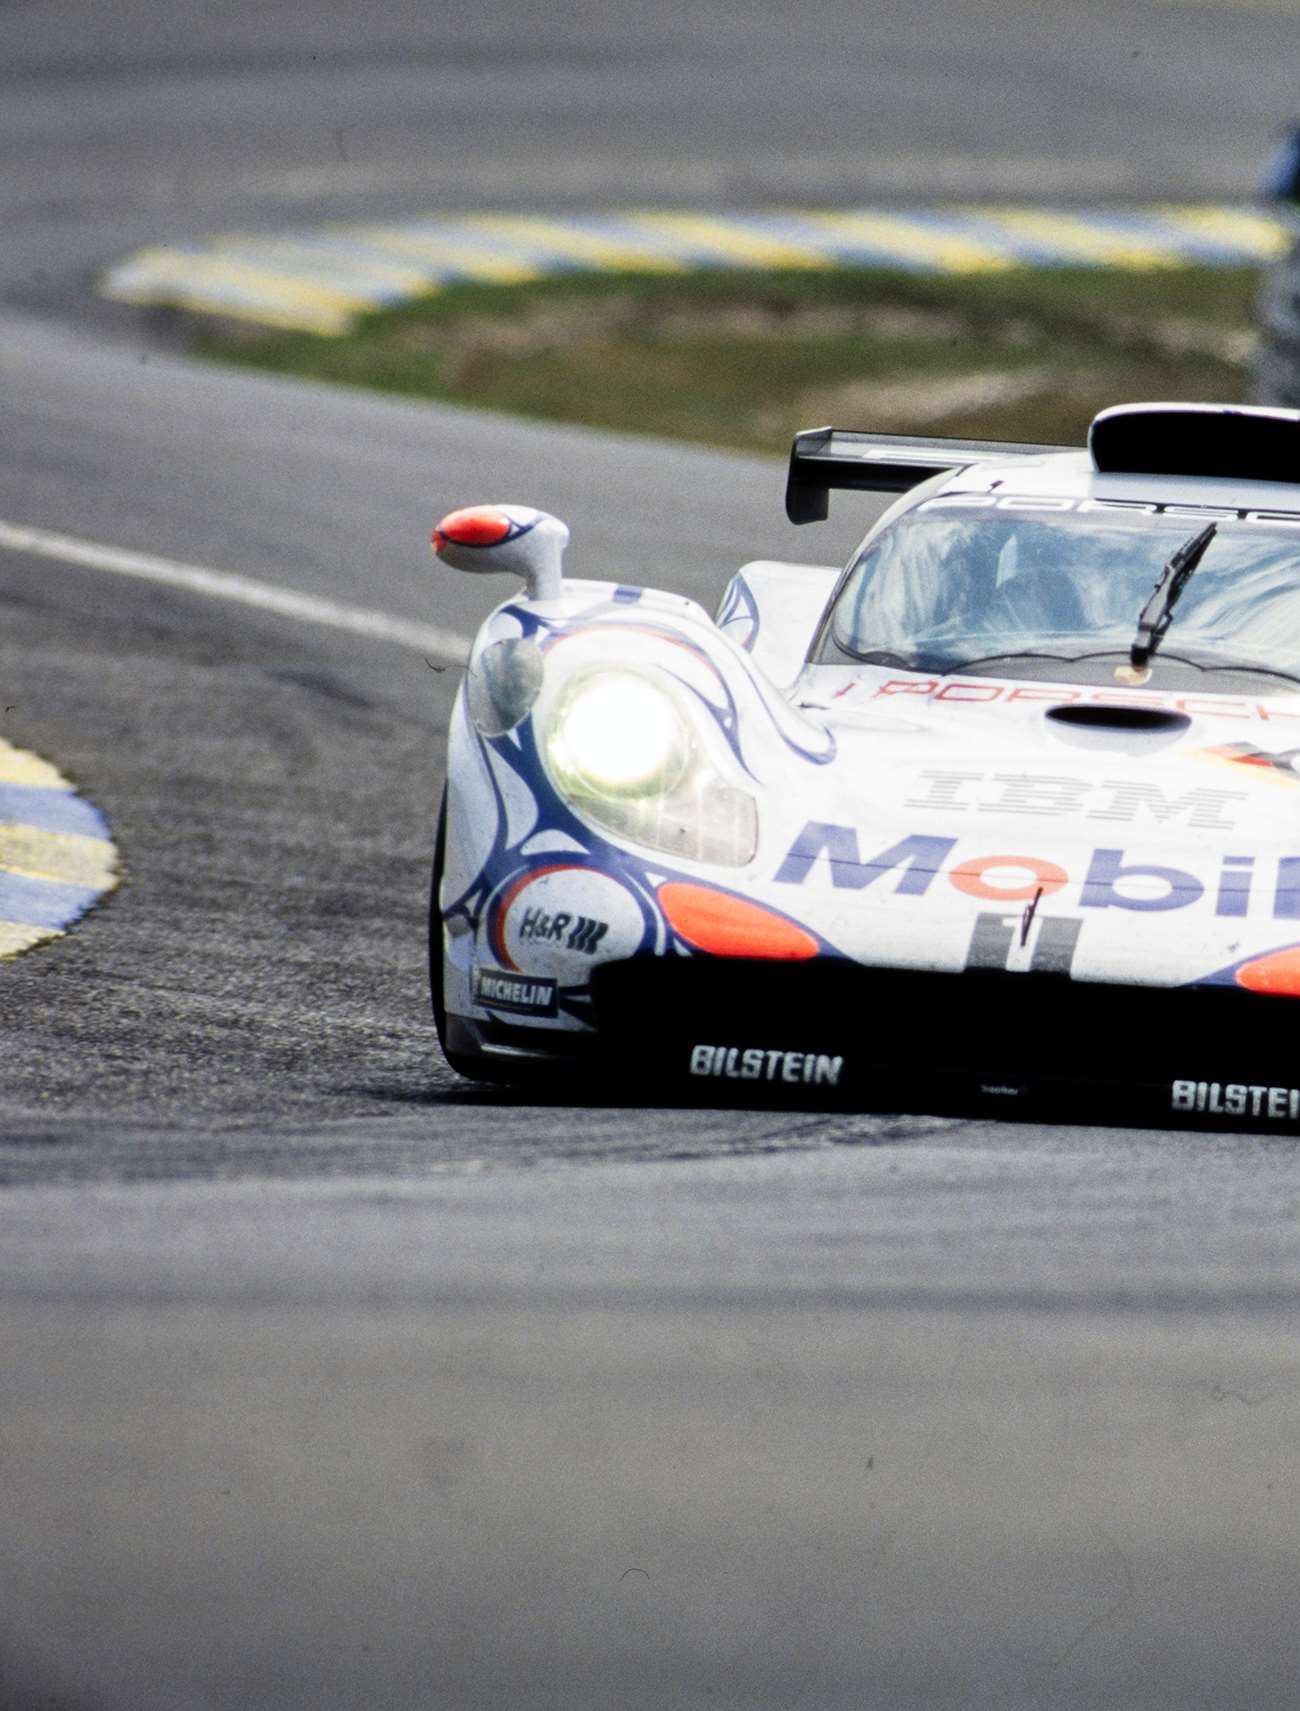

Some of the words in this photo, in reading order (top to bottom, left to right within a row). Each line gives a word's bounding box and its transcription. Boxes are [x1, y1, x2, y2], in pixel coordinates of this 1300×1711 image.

[904, 769, 1248, 830] IBM
[519, 907, 568, 943] H&R
[481, 976, 553, 1006] MICHELIN
[690, 1044, 844, 1085] BILSTEIN
